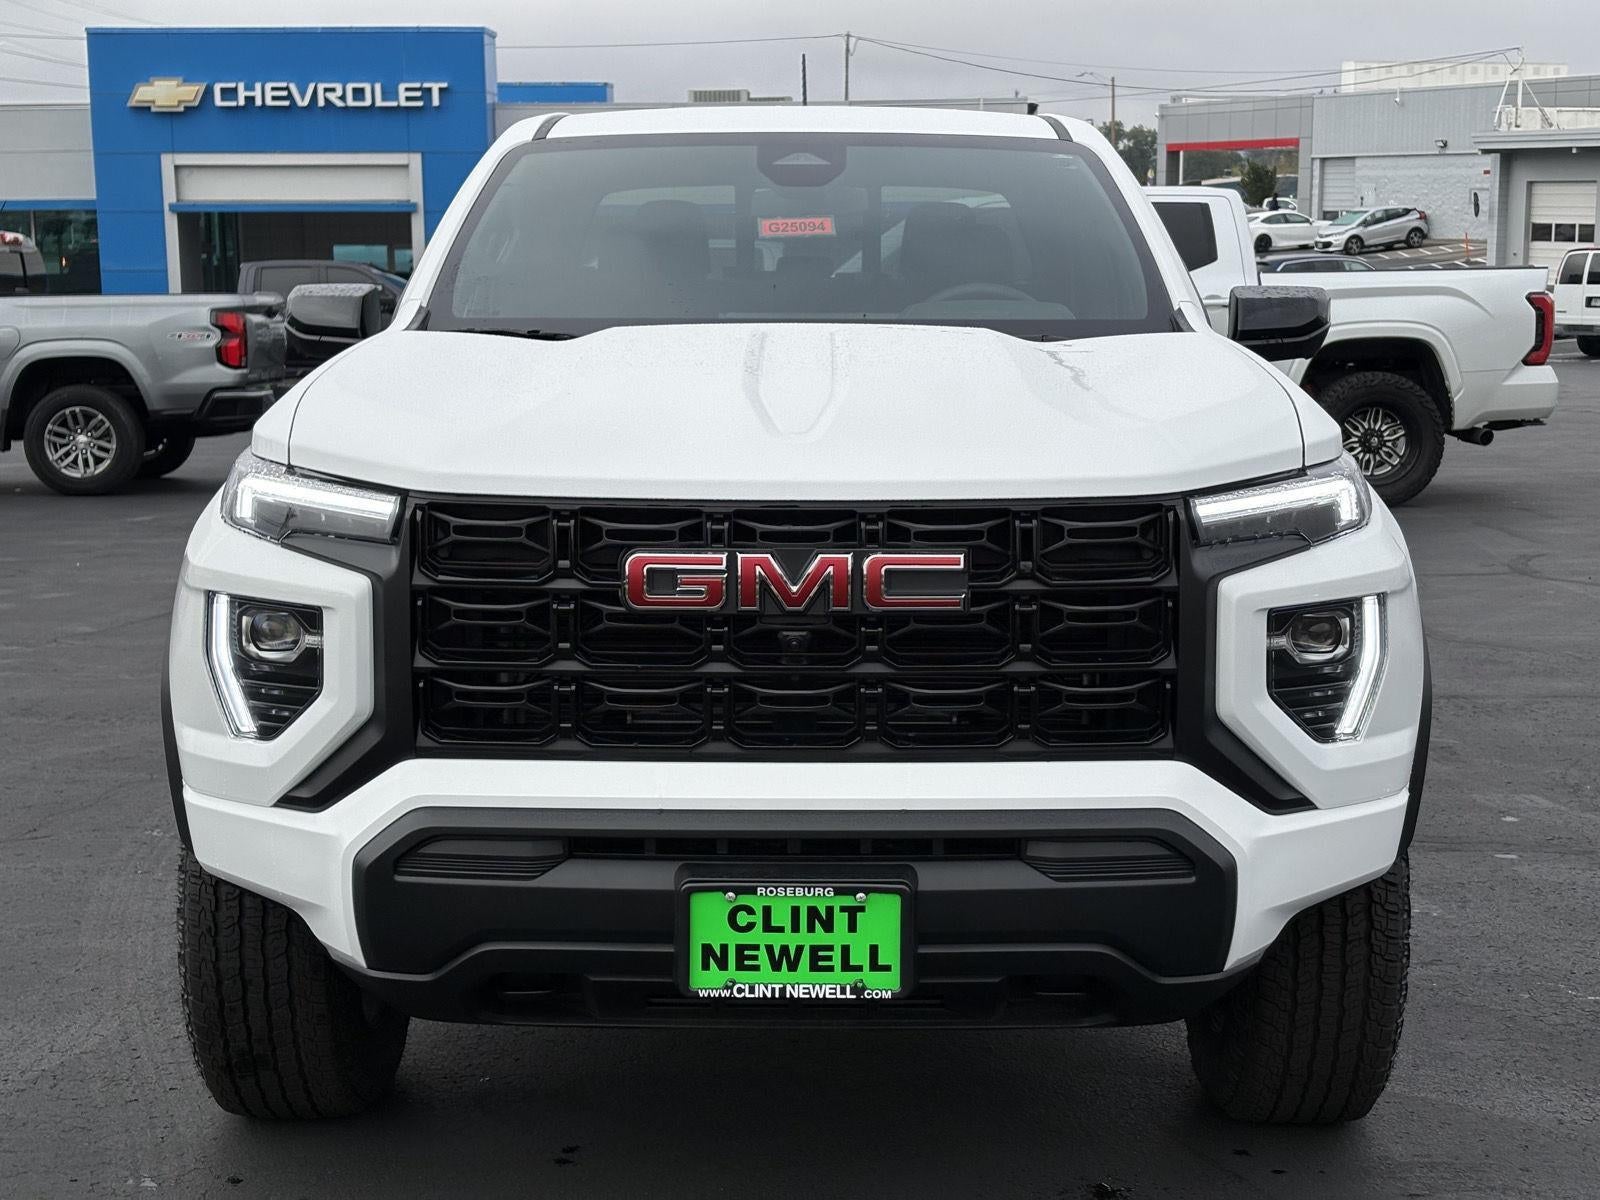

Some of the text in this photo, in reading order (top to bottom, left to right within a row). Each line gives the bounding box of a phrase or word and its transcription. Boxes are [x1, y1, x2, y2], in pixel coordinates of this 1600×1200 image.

[213, 81, 448, 108] CHEVROLET
[768, 220, 826, 233] G25094
[625, 551, 966, 611] GMC
[757, 886, 835, 898] ROSEBURG
[727, 903, 866, 934] CLINT
[701, 943, 893, 973] NEWELL
